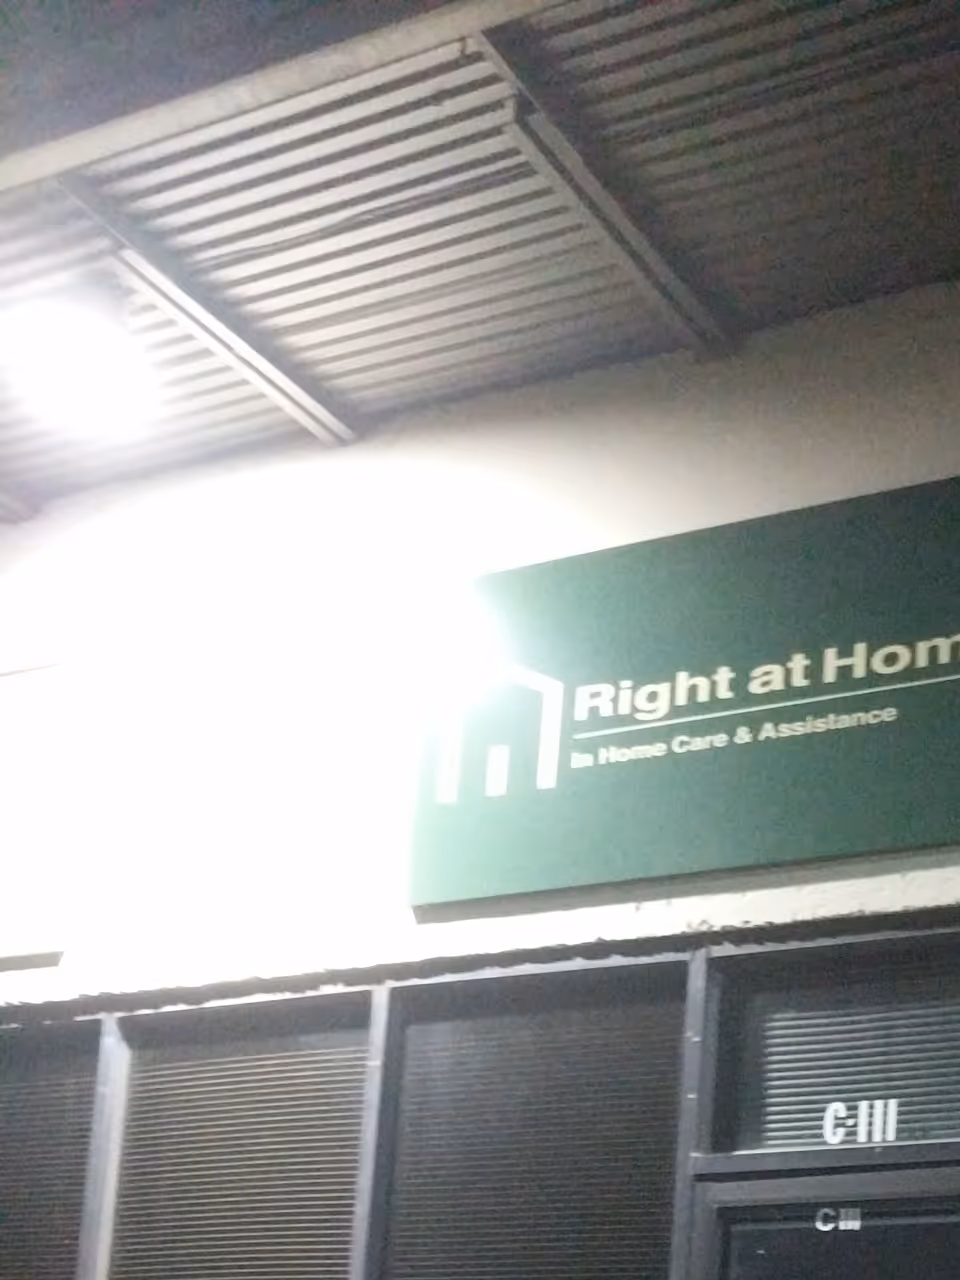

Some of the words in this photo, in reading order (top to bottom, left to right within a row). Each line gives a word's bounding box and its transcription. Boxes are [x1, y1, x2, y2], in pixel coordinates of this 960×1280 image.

[573, 664, 737, 722] Right
[747, 652, 811, 695] at
[598, 740, 668, 766] Home
[671, 731, 729, 754] Care
[732, 726, 753, 744] &
[757, 705, 899, 741] Assistance
